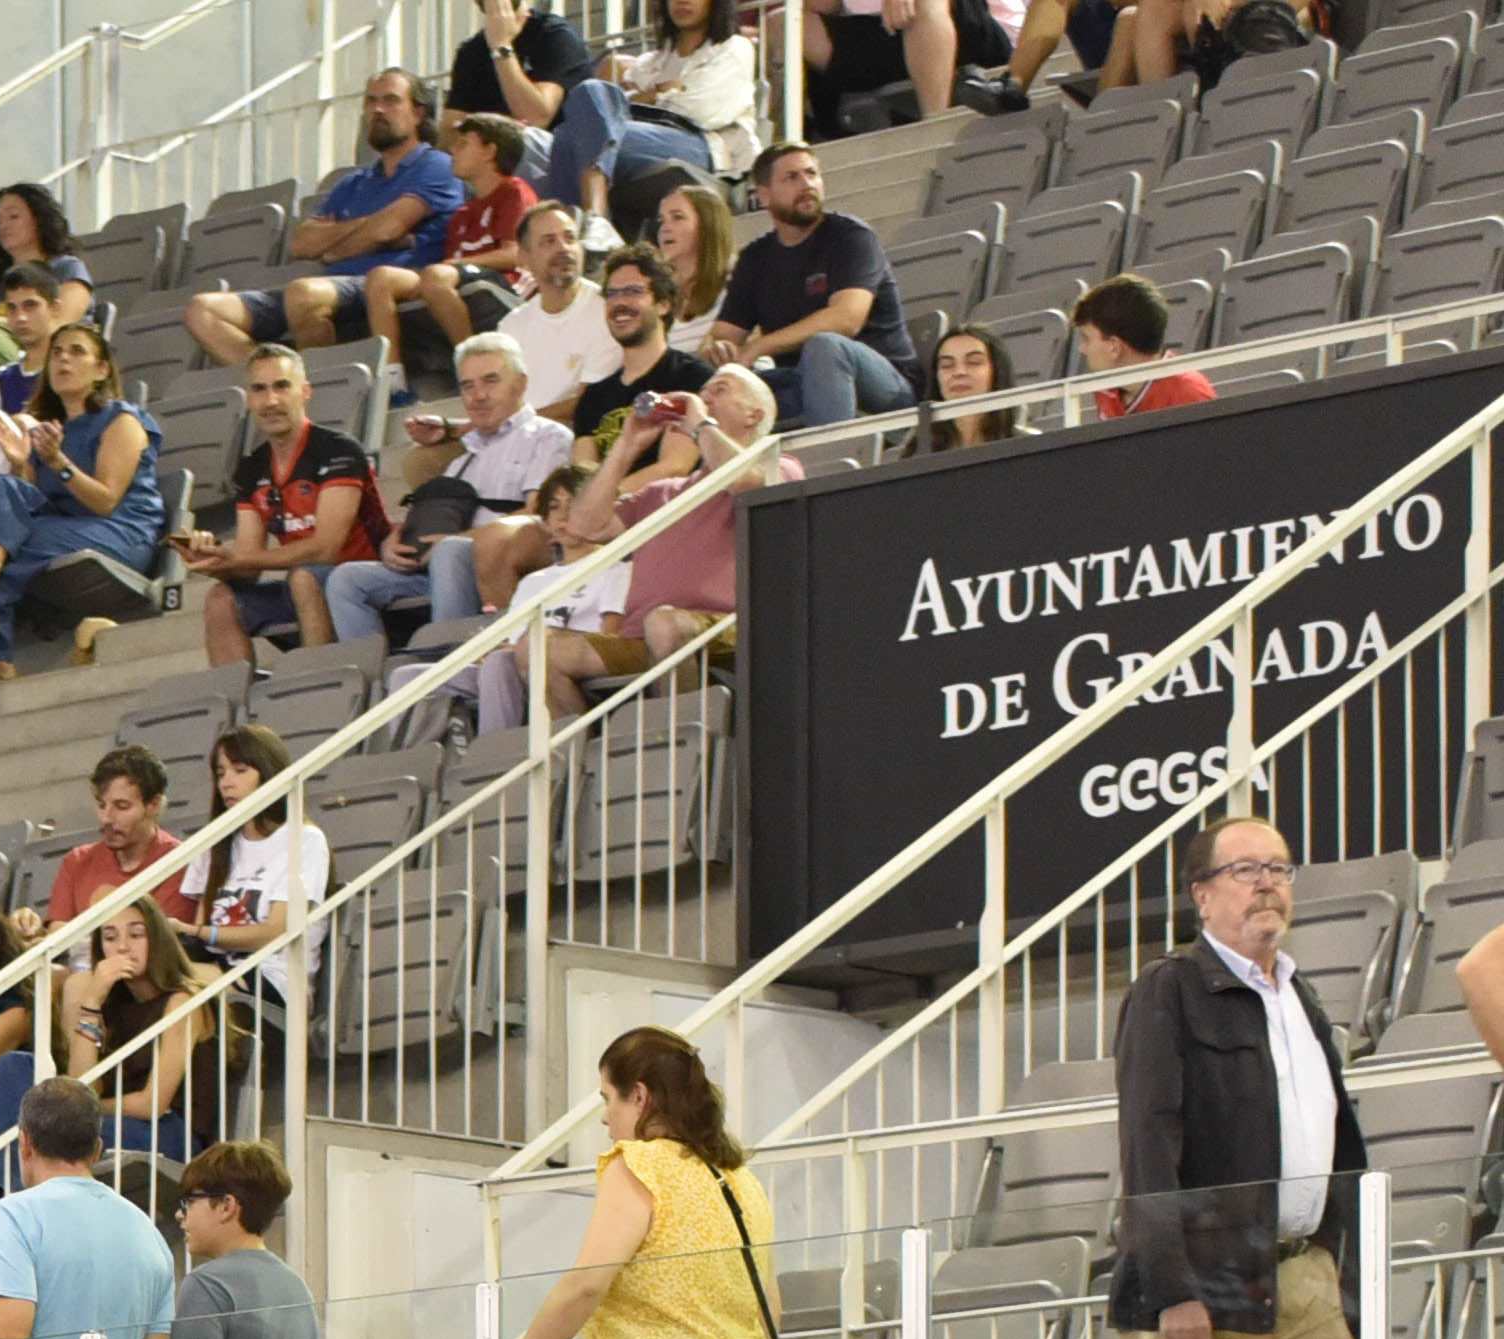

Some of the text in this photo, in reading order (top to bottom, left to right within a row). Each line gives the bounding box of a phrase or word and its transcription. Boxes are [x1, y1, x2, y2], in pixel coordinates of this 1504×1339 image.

[899, 493, 1443, 642] AYUNTAMIENTO
[940, 611, 1390, 738] DE GRANADA
